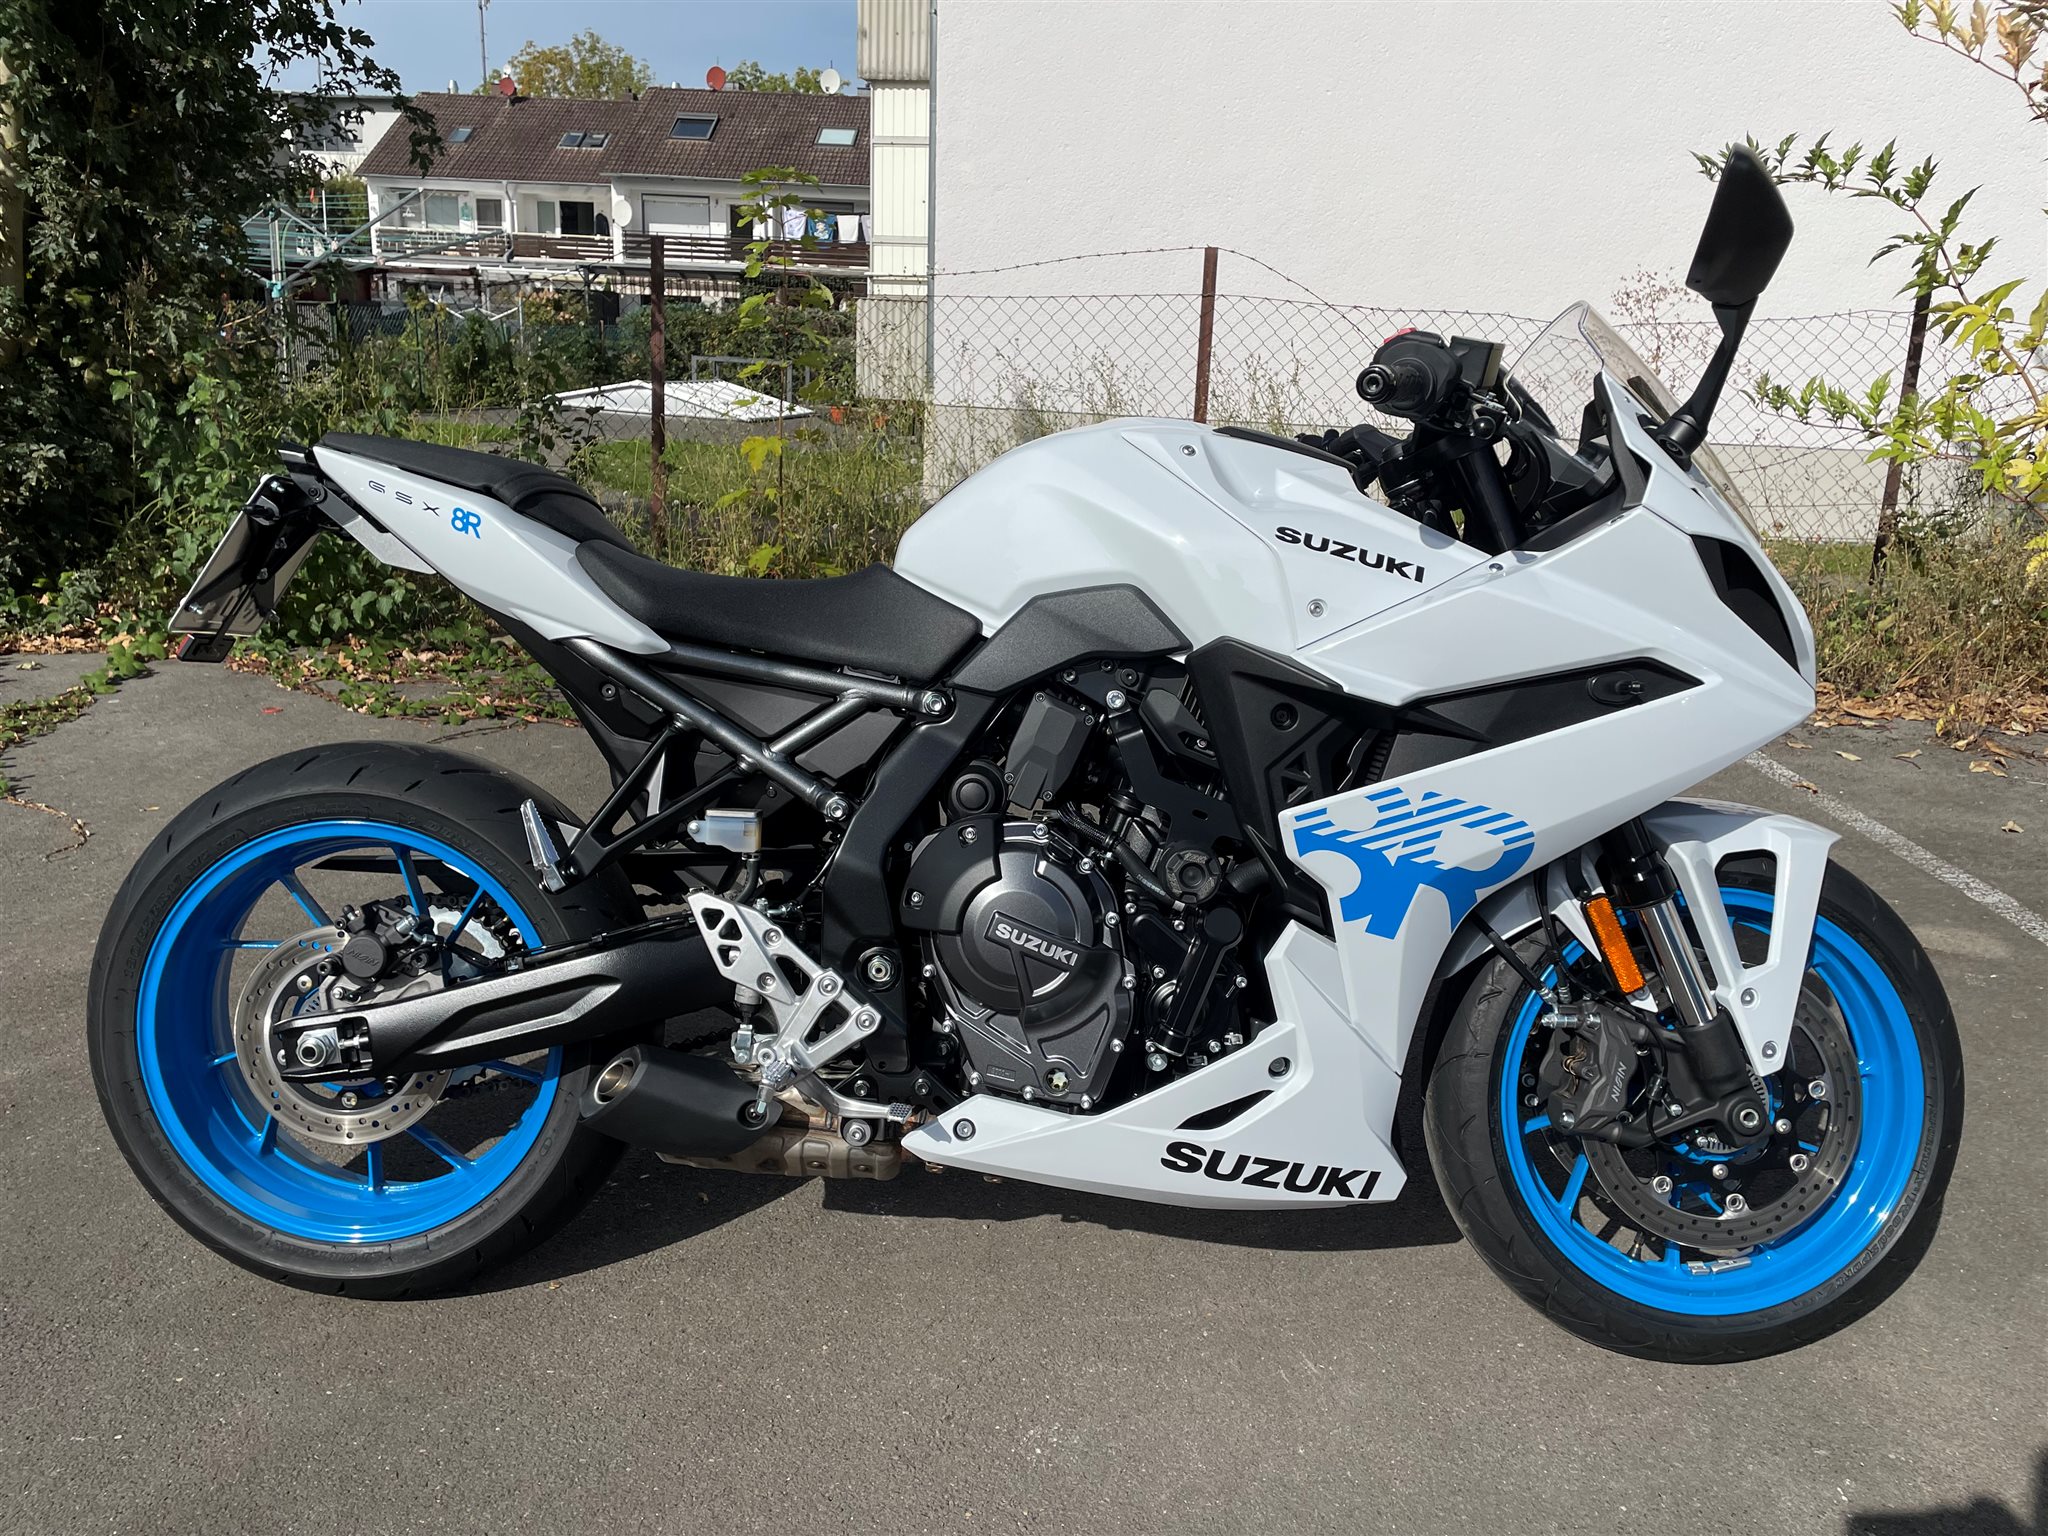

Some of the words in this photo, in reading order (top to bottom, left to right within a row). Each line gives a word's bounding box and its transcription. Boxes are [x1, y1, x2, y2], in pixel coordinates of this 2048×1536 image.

[368, 480, 440, 517] GSX
[451, 507, 482, 539] 8R
[1275, 526, 1425, 584] SUZUKI
[995, 923, 1078, 967] SUZUKI
[1160, 1141, 1382, 1200] SUZUKI
